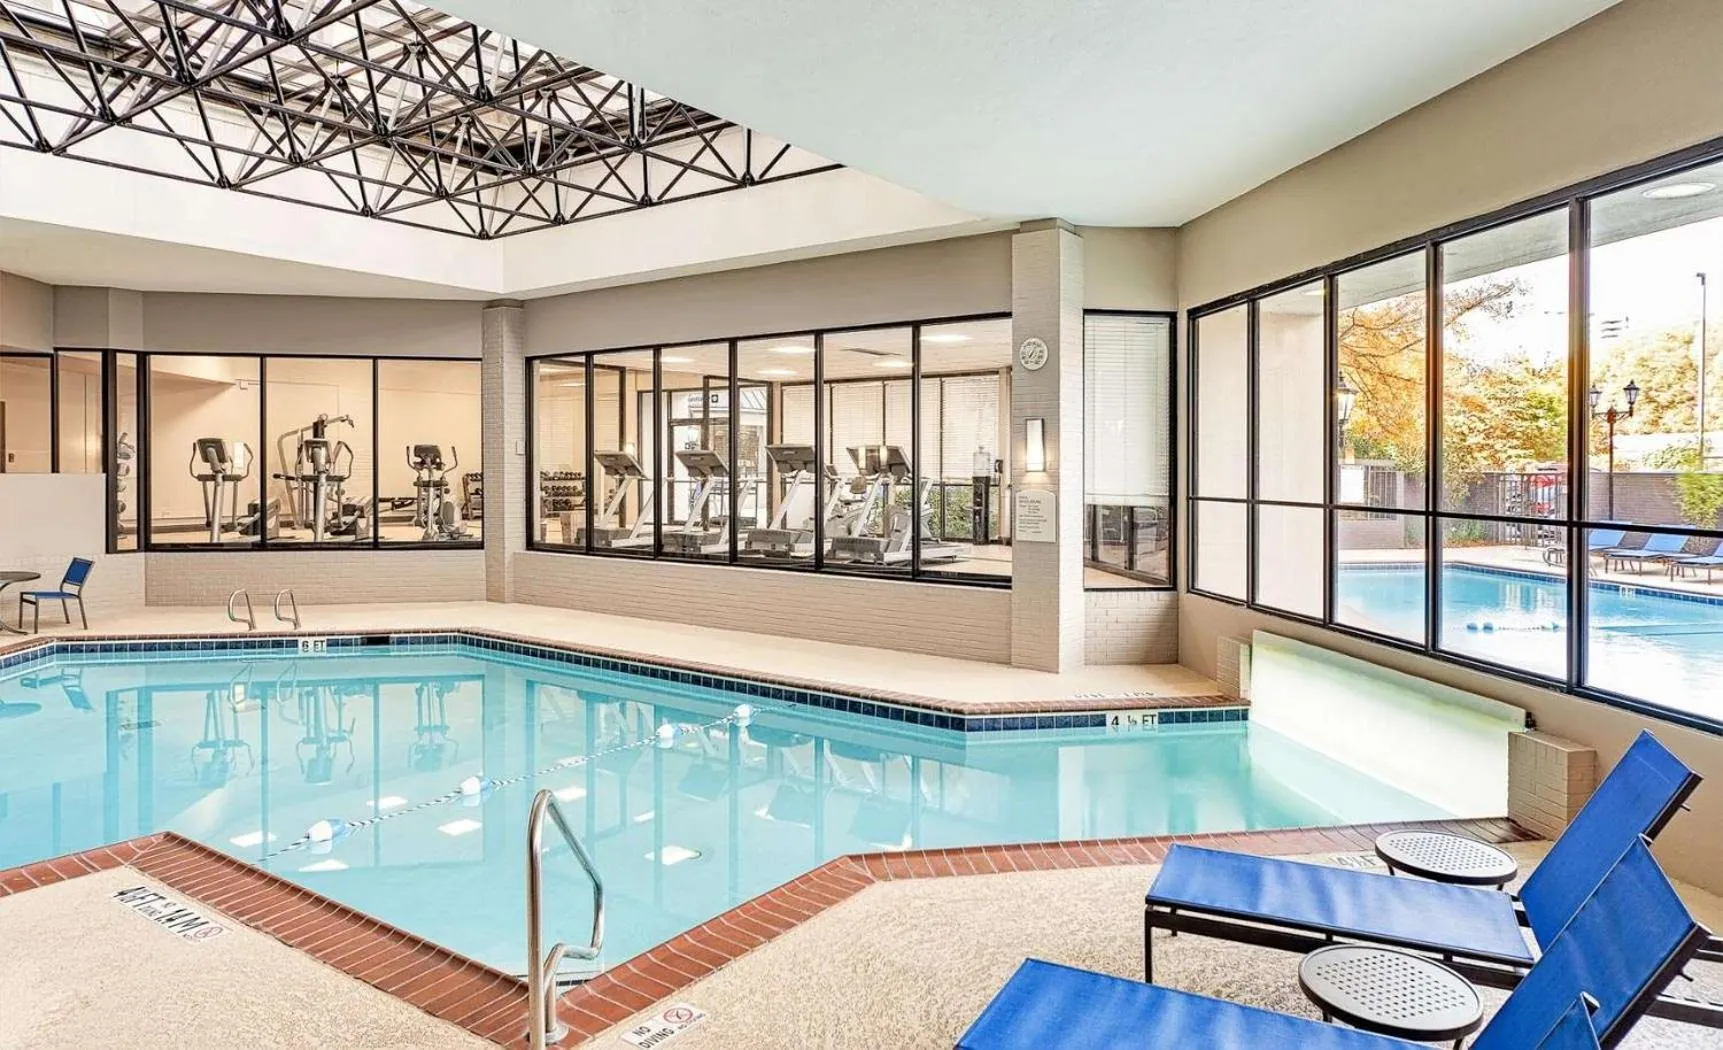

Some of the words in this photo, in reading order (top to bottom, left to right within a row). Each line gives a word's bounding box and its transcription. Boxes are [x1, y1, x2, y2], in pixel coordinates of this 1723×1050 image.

[1111, 715, 1119, 725] 4
[1142, 714, 1156, 725] FT
[632, 1026, 651, 1037] NO
[639, 1027, 675, 1048] DIVING
